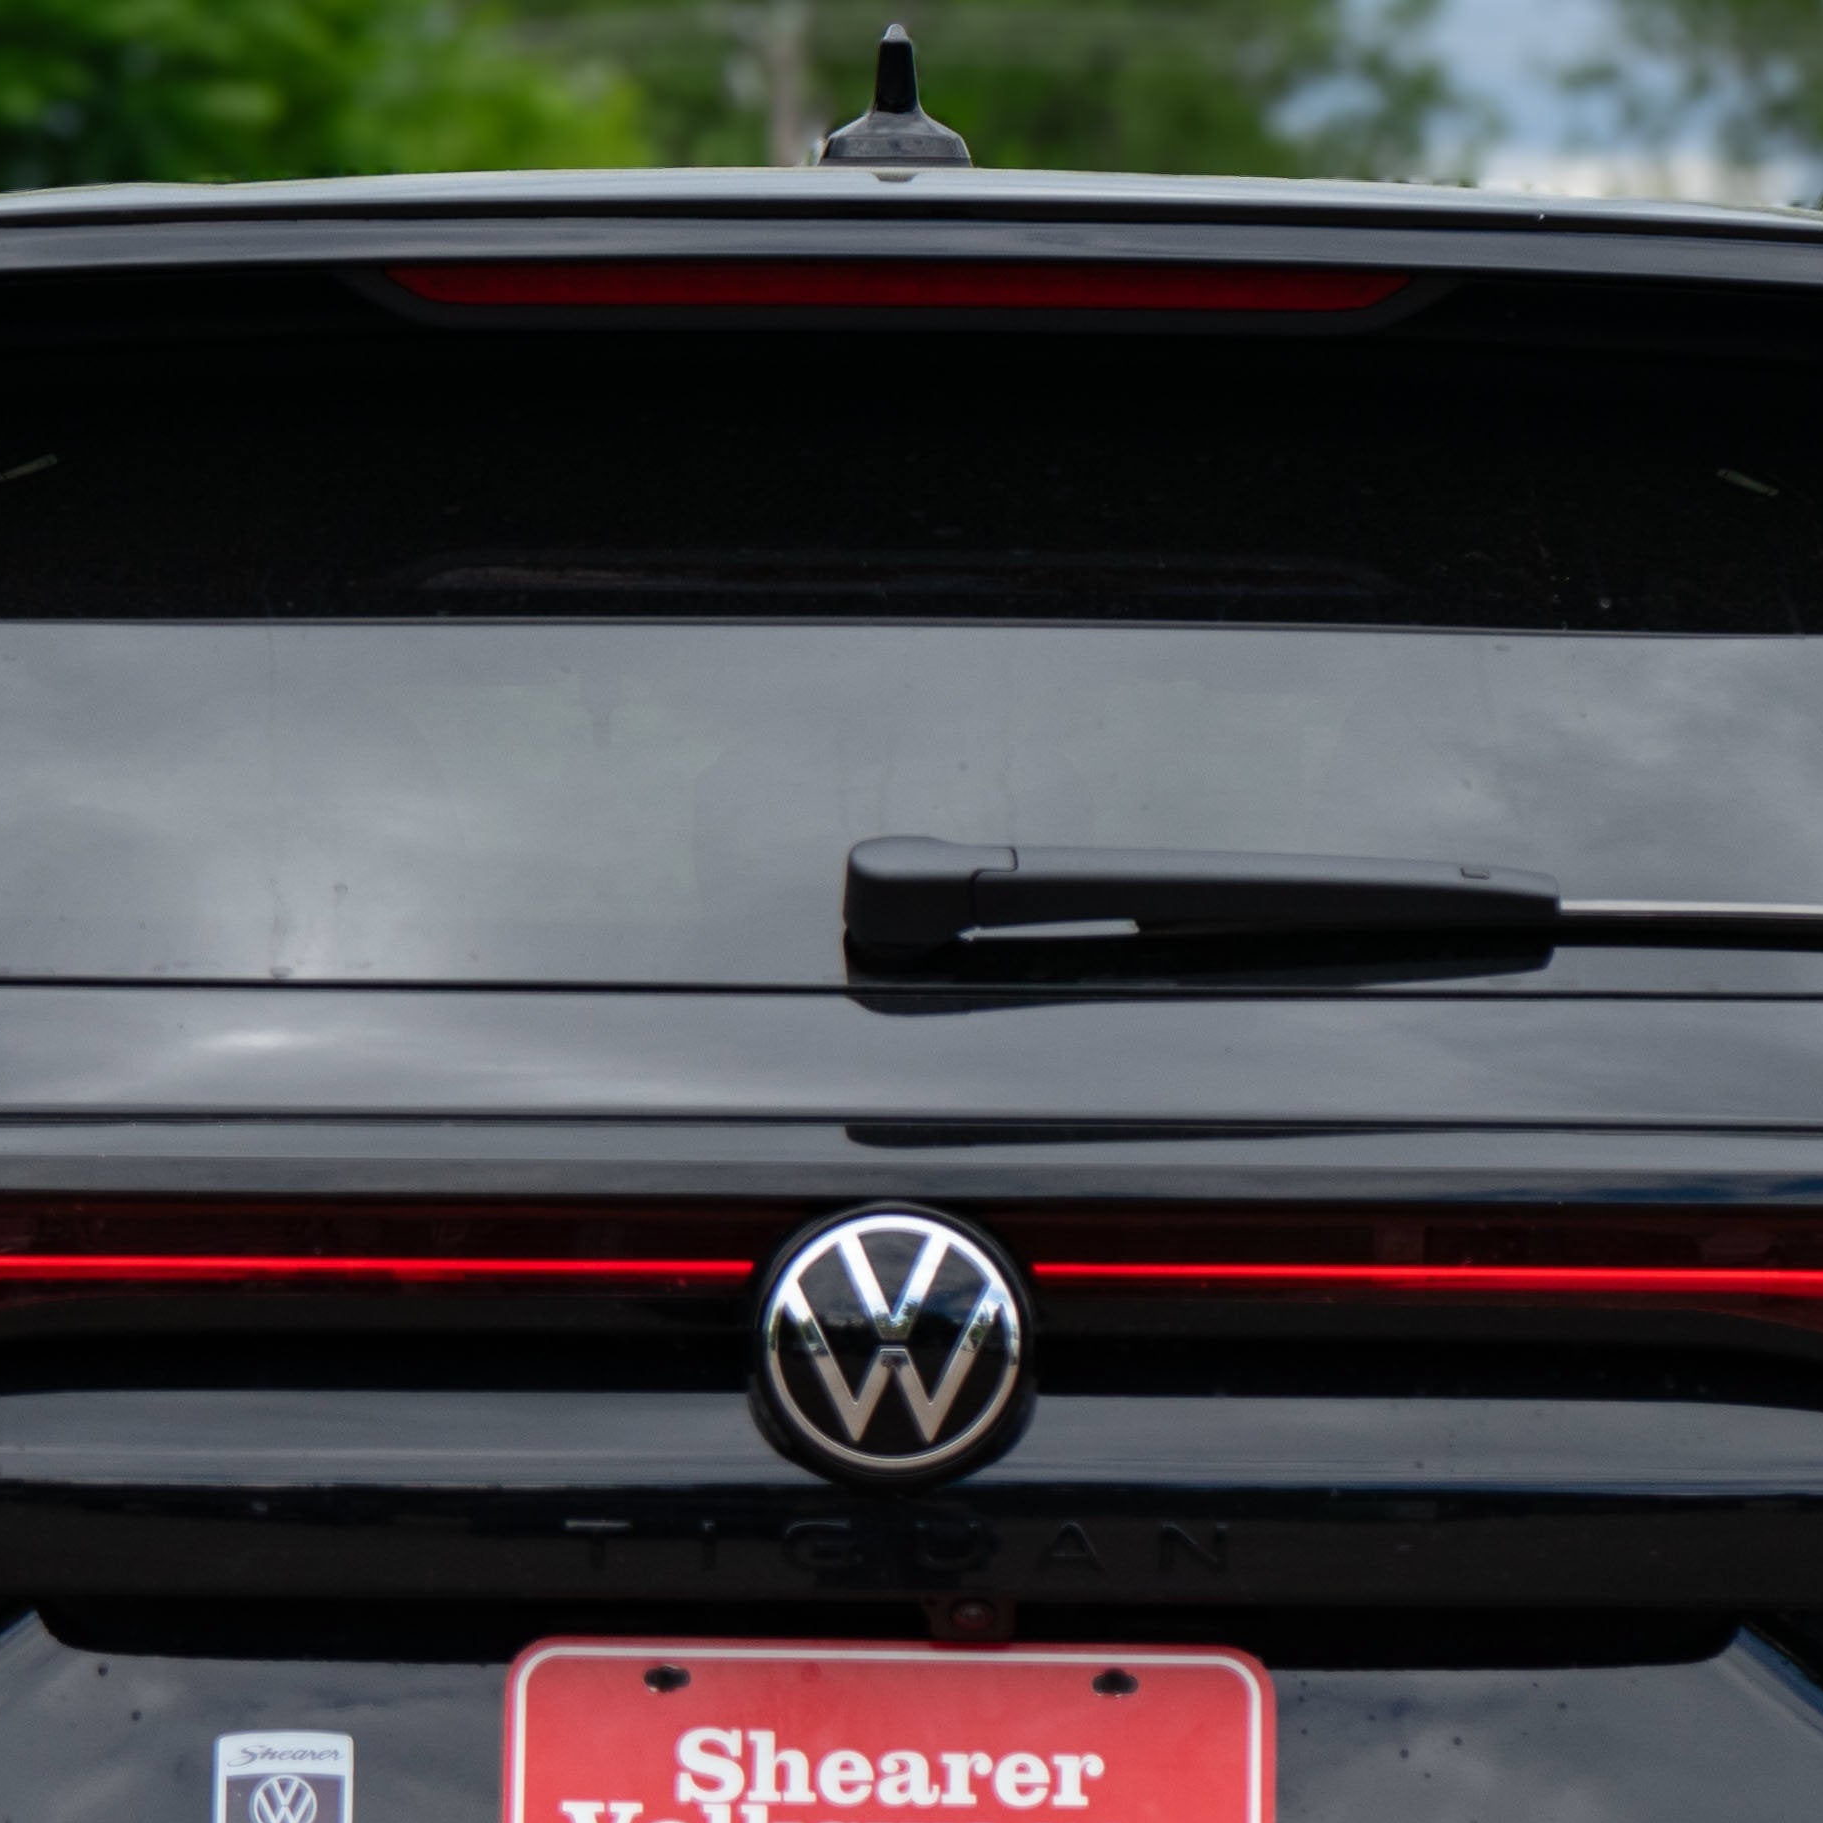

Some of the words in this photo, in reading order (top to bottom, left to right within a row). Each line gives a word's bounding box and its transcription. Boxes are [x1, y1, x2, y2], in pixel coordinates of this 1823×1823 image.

[563, 1517, 1227, 1572] TIGUAN
[227, 1744, 343, 1768] Shearer
[675, 1726, 1105, 1808] Shearer
